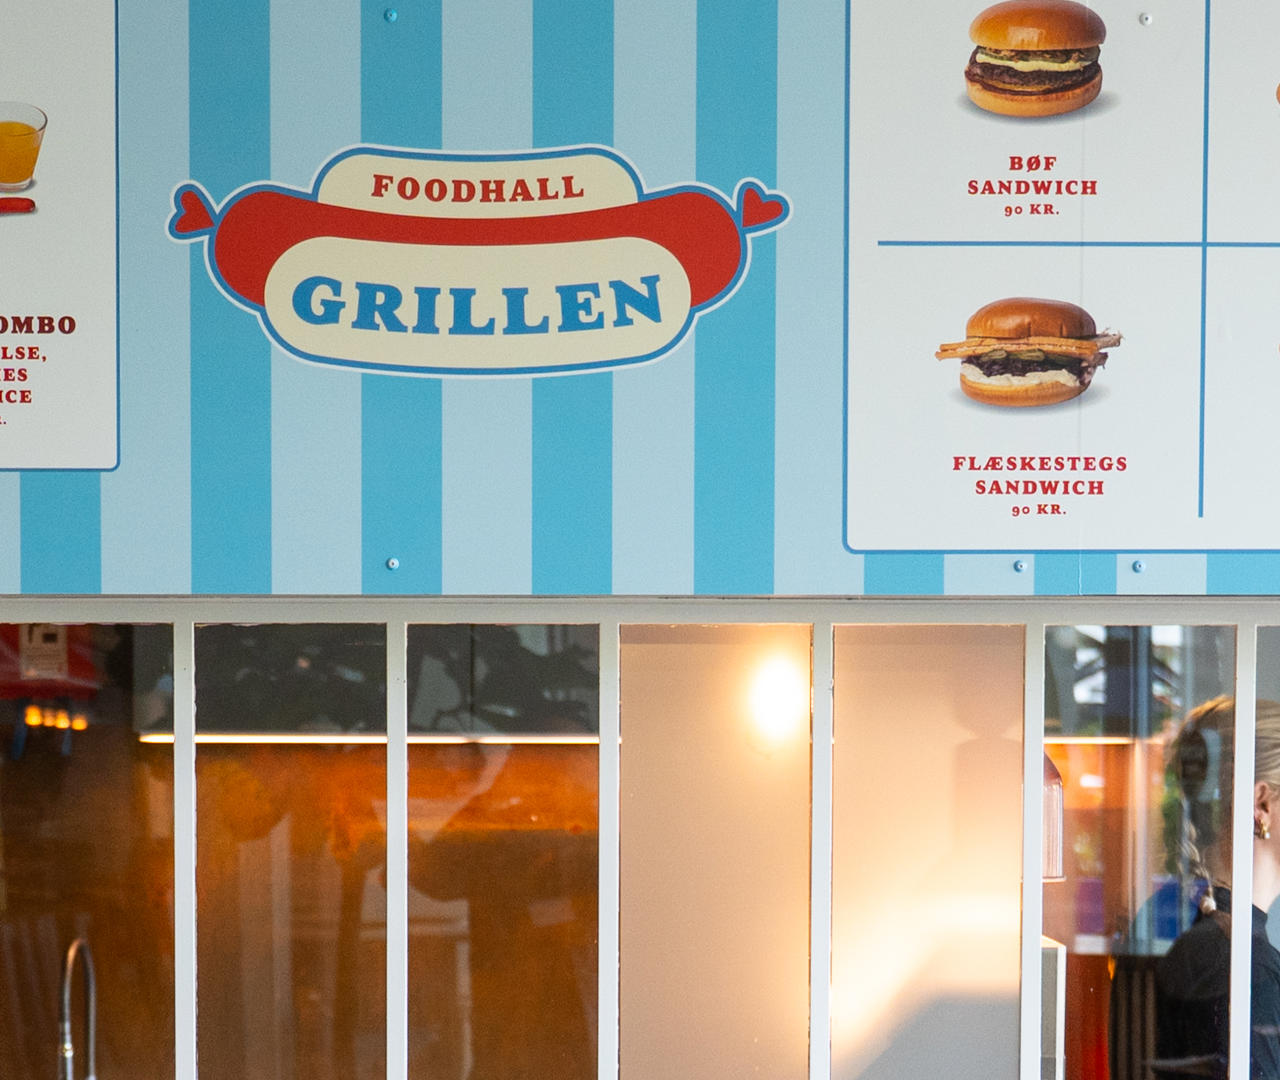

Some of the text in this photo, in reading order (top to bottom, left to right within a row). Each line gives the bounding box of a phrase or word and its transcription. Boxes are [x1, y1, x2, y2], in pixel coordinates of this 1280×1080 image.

[1009, 154, 1057, 173] BØF
[371, 173, 585, 203] FOODHALL
[967, 179, 1097, 196] SANDWICH
[1004, 202, 1060, 217] 90 KR.
[291, 274, 662, 337] GRILLEN
[953, 455, 1128, 472] FLÆSKESTEGS
[975, 479, 1104, 496] SANDWICH
[1011, 503, 1067, 517] 90 KR.
